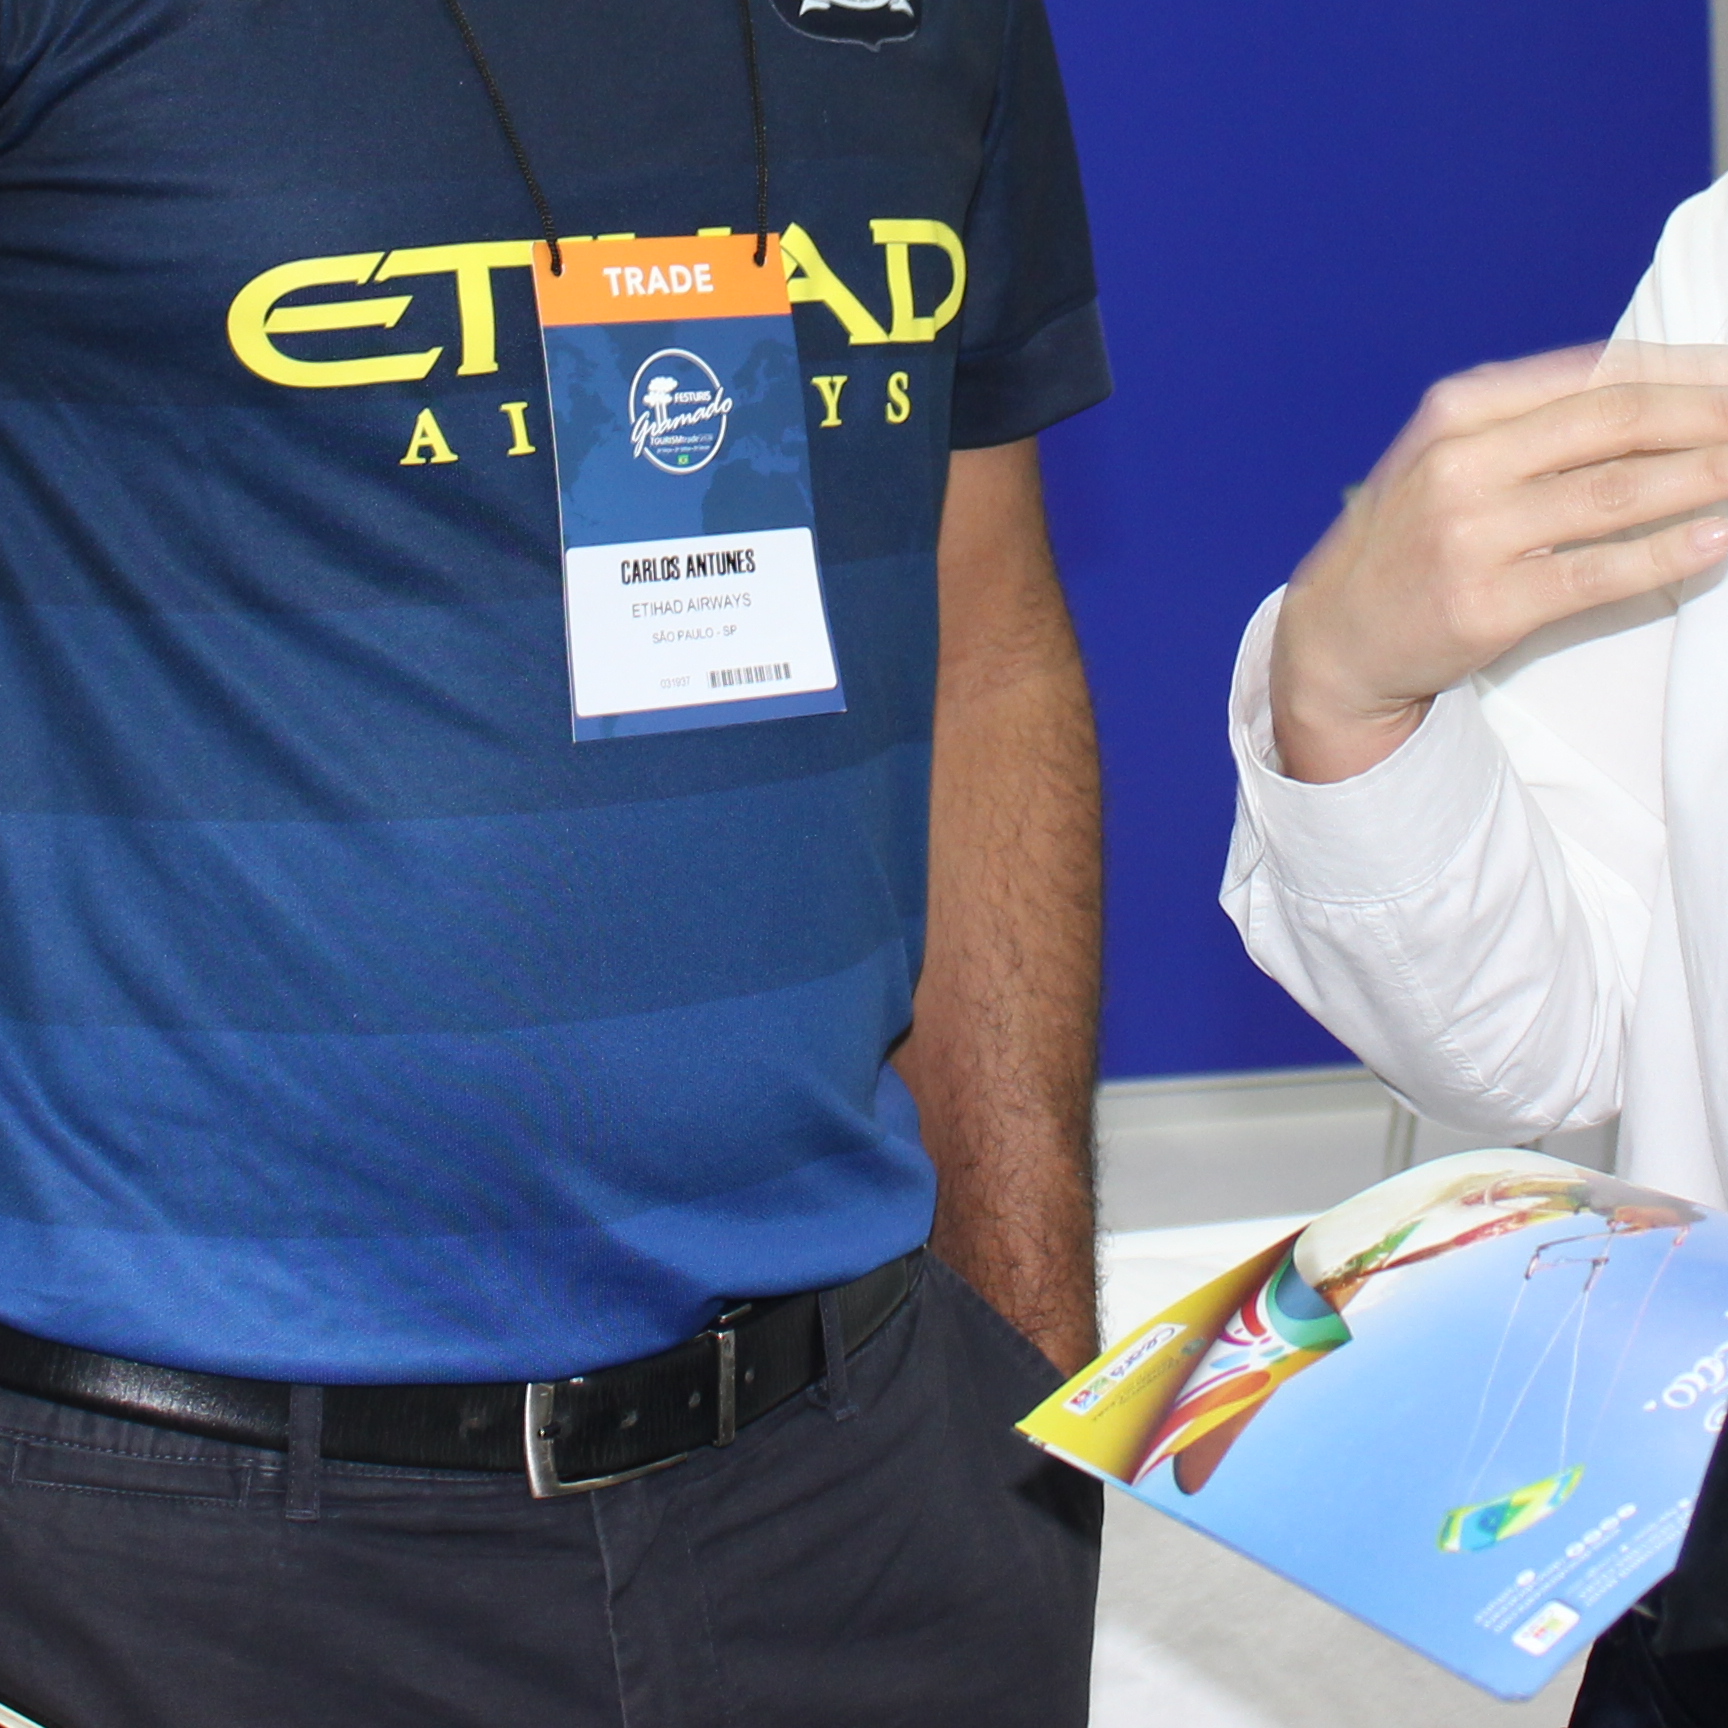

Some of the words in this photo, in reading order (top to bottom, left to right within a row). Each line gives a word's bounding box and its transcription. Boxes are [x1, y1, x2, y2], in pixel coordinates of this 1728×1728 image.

[603, 263, 714, 298] TRADE
[227, 218, 967, 388] ETAD
[400, 372, 910, 466] AIYS
[621, 555, 681, 585] CARLOS
[685, 548, 756, 579] ANTUNES
[632, 599, 683, 618] ETIHAD
[687, 592, 752, 612] AIRWAYS
[677, 627, 714, 642] PAULO
